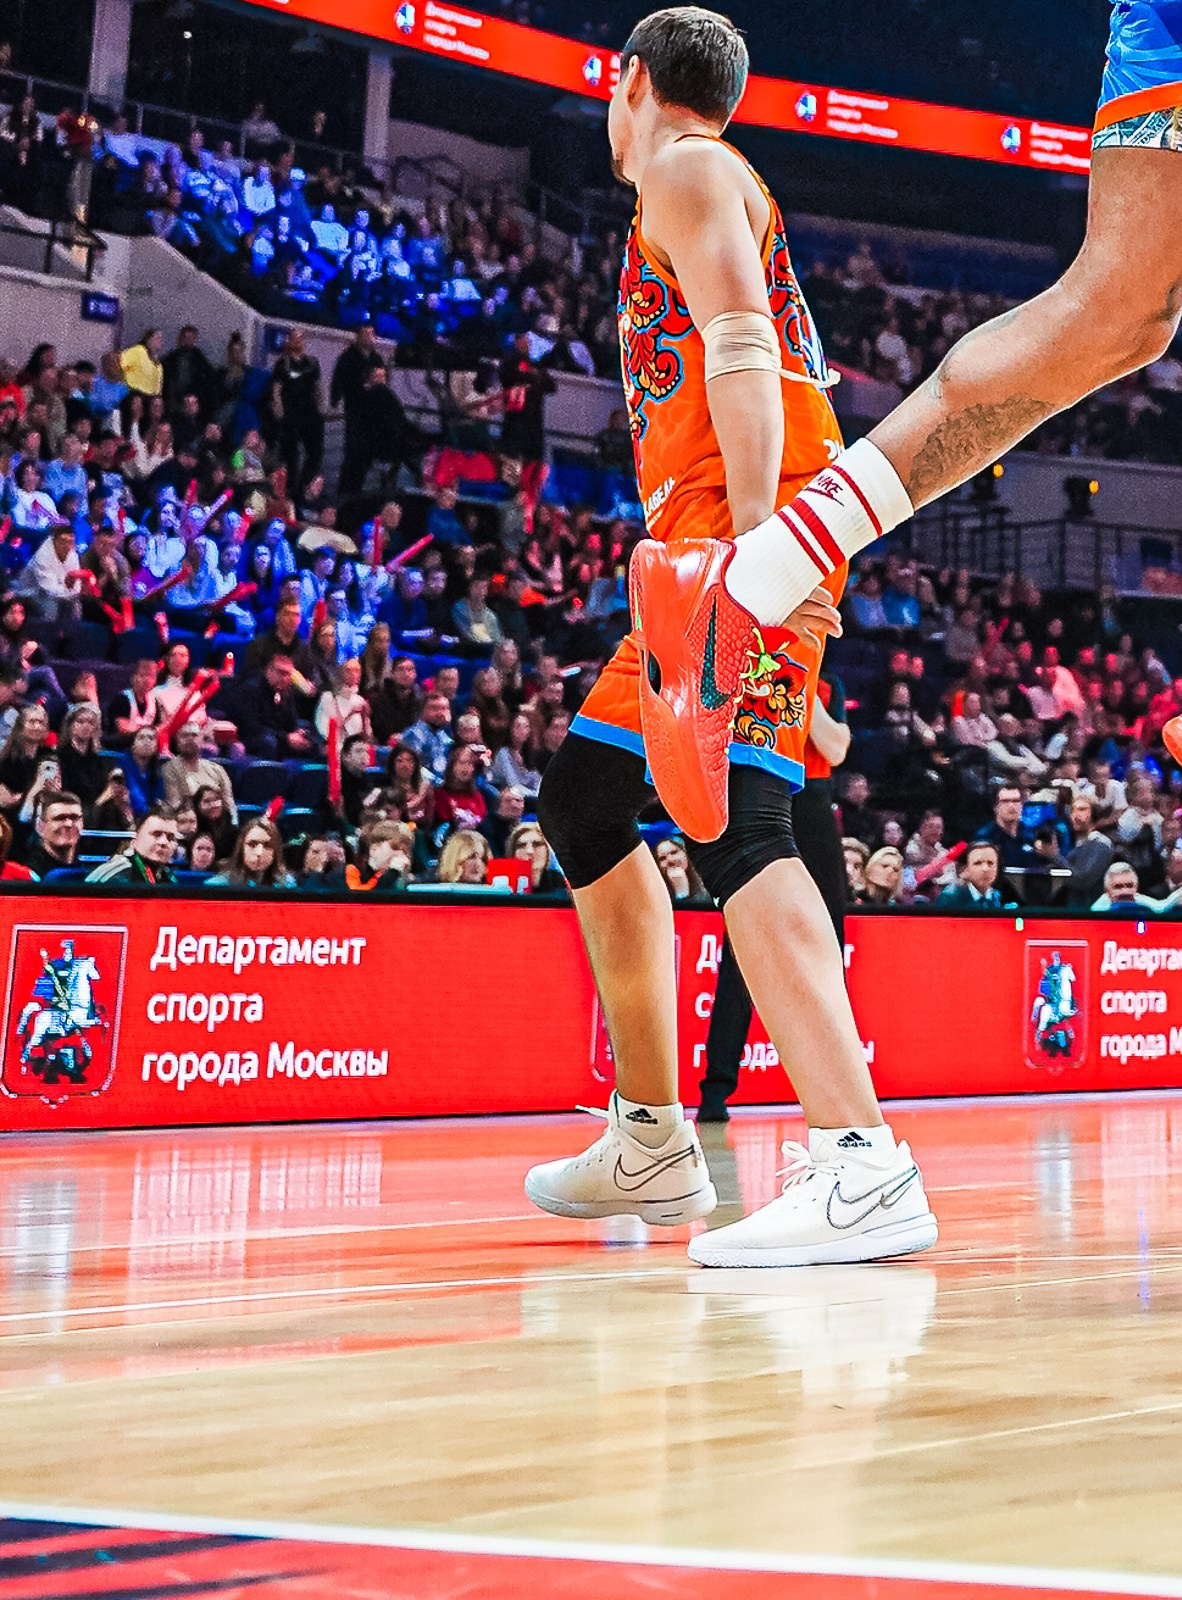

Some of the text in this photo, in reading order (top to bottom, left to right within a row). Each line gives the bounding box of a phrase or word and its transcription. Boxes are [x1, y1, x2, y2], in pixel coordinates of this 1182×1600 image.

[150, 926, 367, 974] Департамент
[147, 992, 264, 1031] спорта
[1101, 989, 1167, 1019] спорта
[142, 1041, 389, 1090] города Москвы
[1101, 1032, 1167, 1064] города
